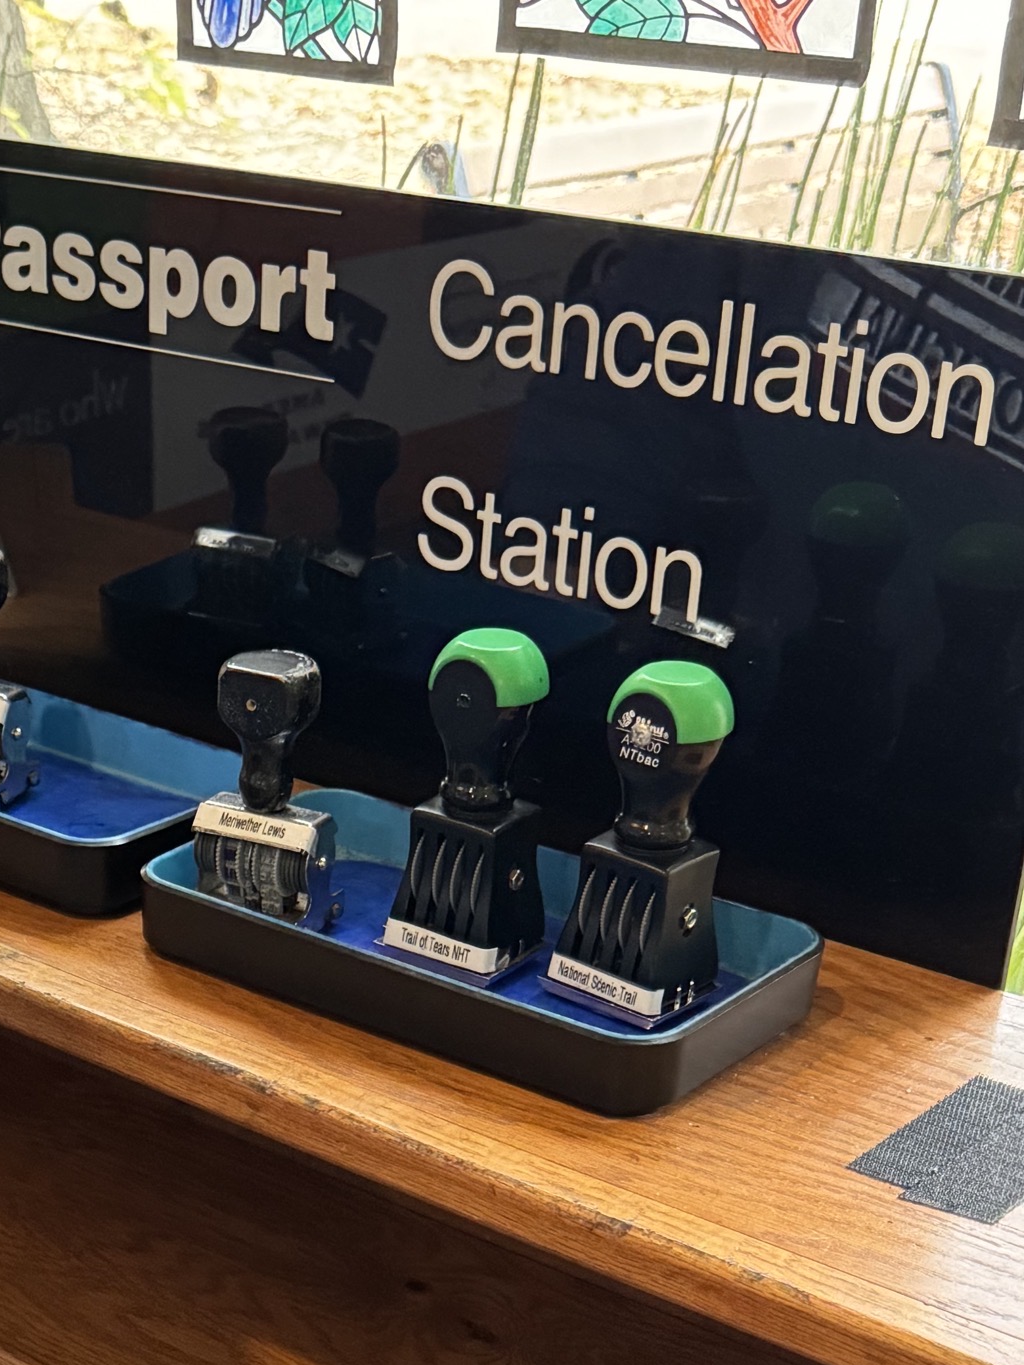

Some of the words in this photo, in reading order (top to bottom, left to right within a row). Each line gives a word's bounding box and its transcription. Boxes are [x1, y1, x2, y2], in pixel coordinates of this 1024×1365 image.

[427, 258, 994, 446] Cancellation
[417, 475, 702, 622] Station
[619, 745, 660, 768] NTbac
[218, 811, 263, 833] Meriwether
[262, 820, 287, 839] Lewis
[401, 926, 419, 945] Trail
[419, 934, 429, 949] of
[429, 937, 450, 958] Tears
[451, 943, 471, 964] NHT
[557, 960, 590, 987] National
[591, 973, 617, 999] Scenic
[618, 985, 638, 1007] Trail
